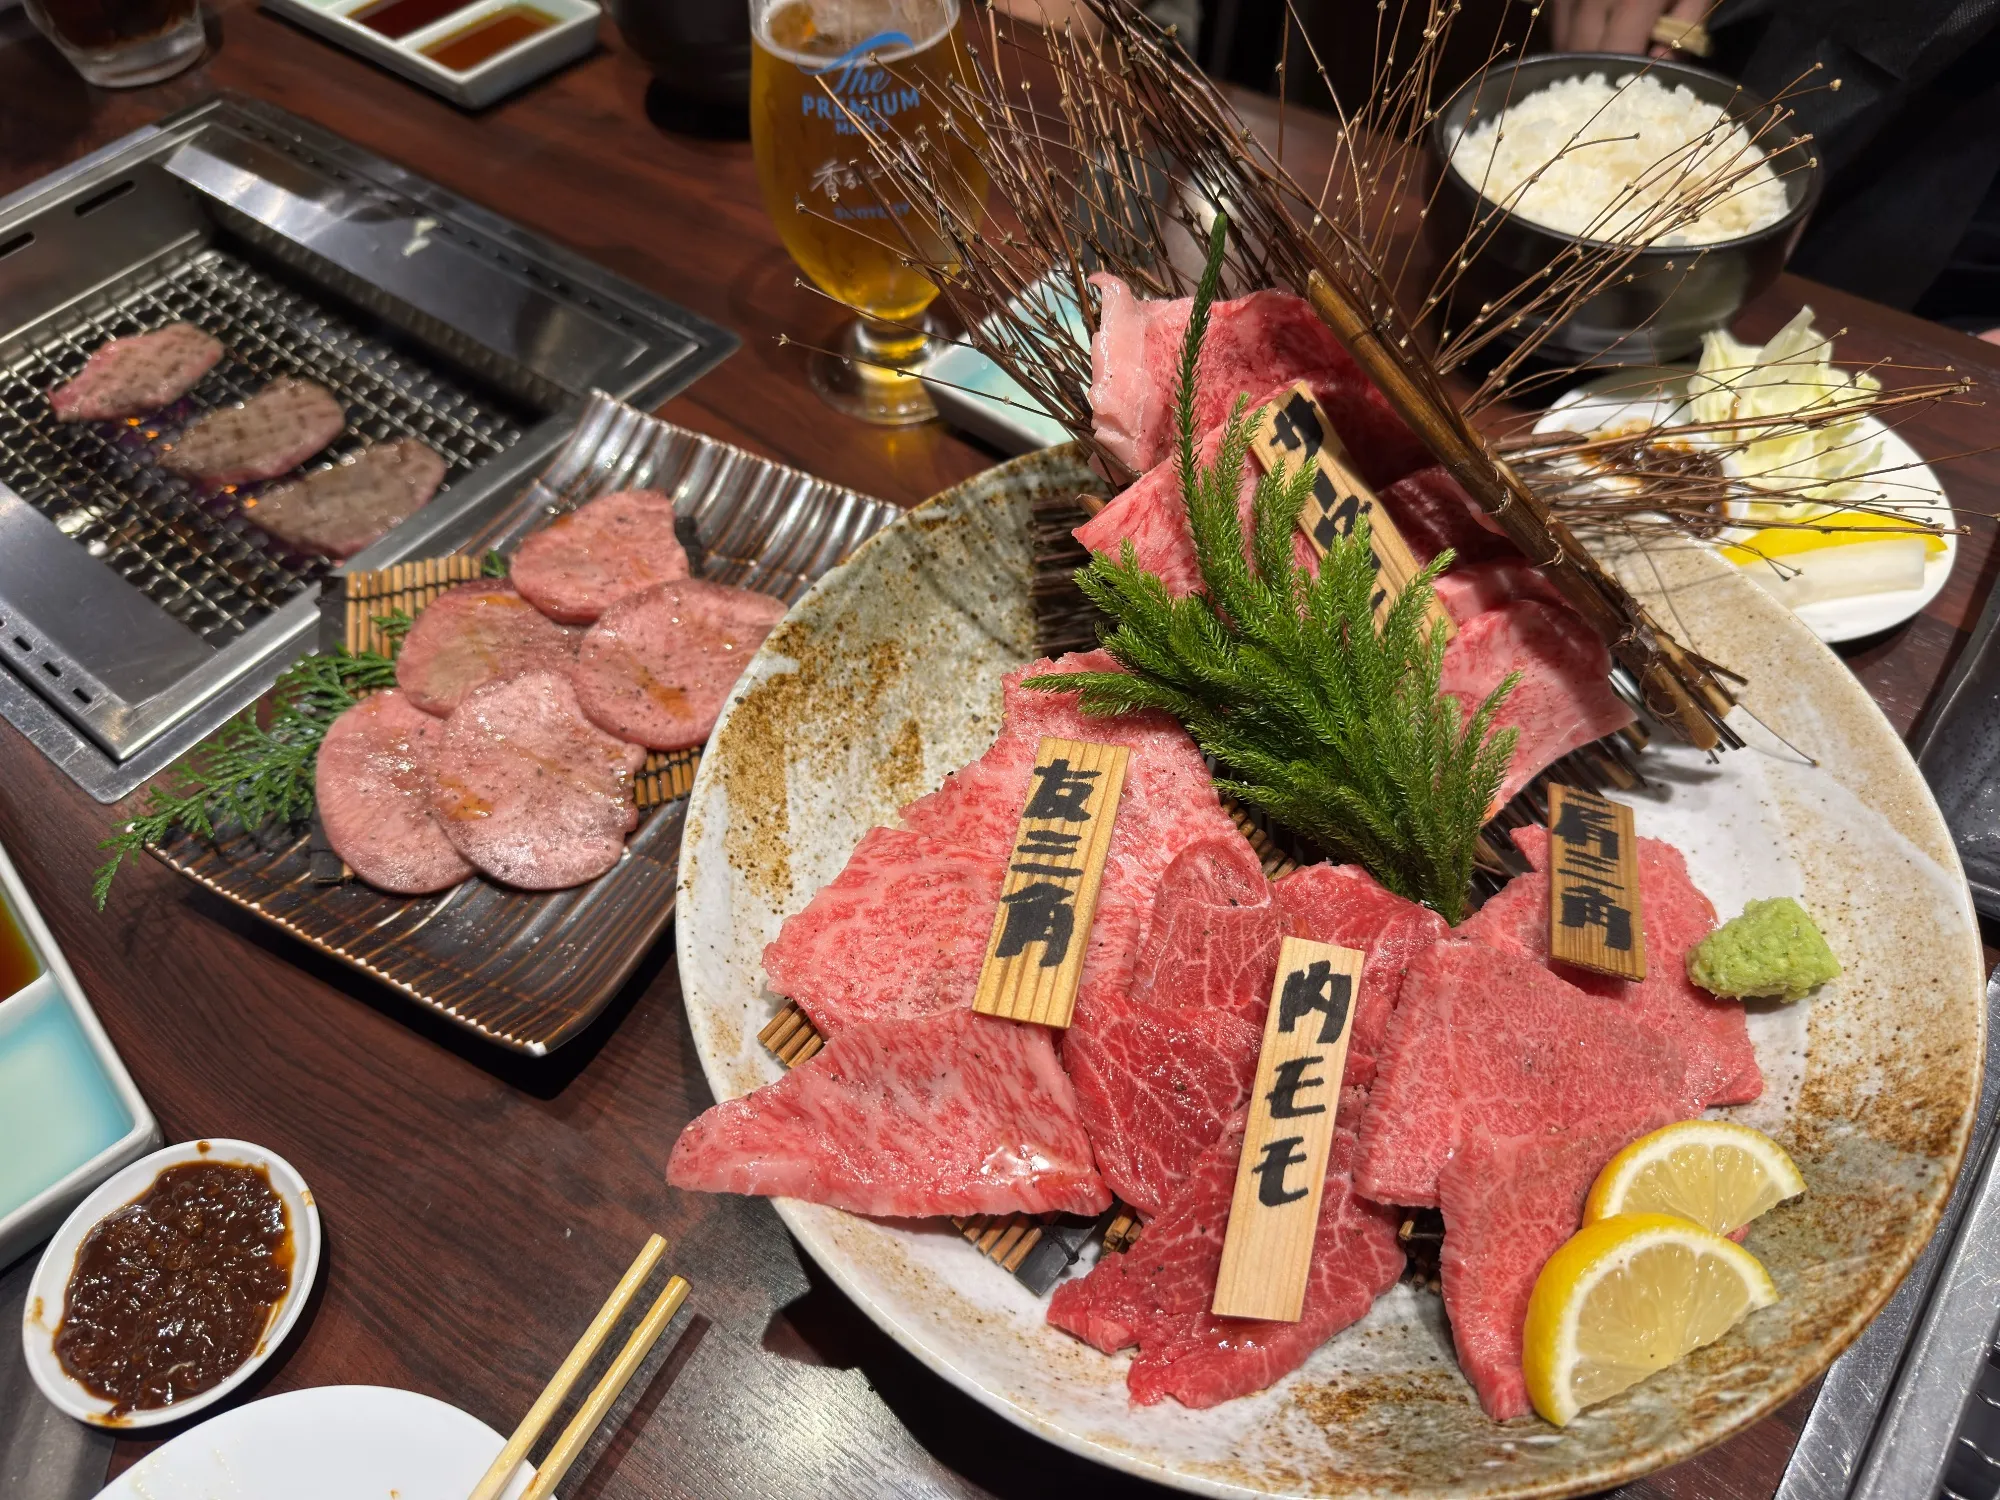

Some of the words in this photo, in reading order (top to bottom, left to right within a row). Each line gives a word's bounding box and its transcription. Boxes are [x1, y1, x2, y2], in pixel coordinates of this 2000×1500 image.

[801, 88, 920, 120] PREMIUM
[835, 118, 889, 136] MAT'S
[1269, 391, 1388, 613] サーロ
[994, 758, 1102, 968] 友三角
[1251, 960, 1352, 1207] 内モモ
